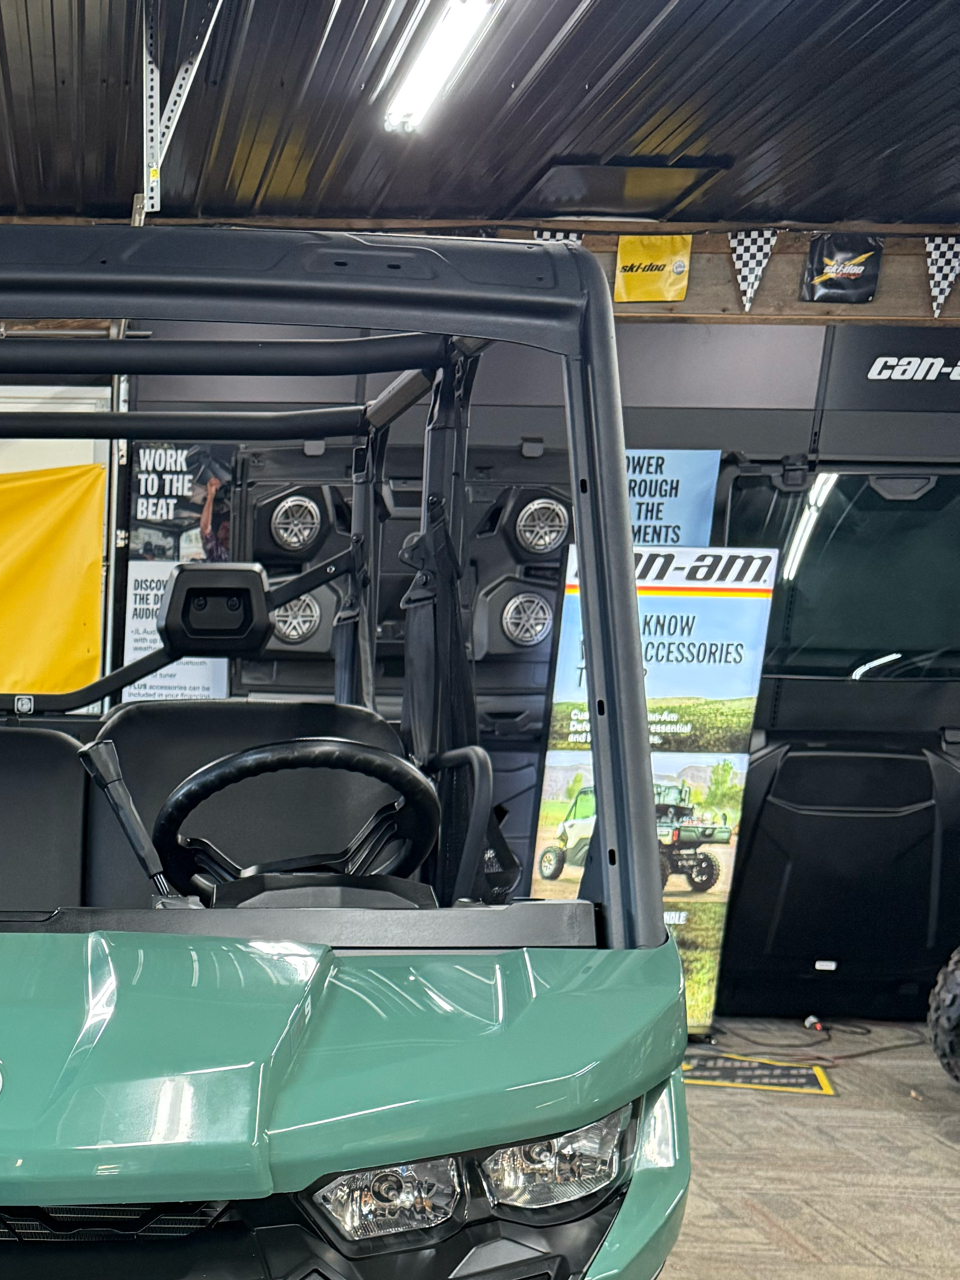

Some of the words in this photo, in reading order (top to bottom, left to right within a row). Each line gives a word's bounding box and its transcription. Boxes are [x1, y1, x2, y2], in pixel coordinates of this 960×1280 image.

[620, 263, 666, 272] ski-doo
[139, 449, 188, 472] WORK
[138, 474, 159, 495] TO
[162, 474, 193, 496] THE
[137, 498, 177, 520] BEAT
[636, 502, 664, 520] THE
[133, 594, 150, 605] THE
[642, 614, 695, 636] KNOW
[644, 641, 744, 664] CCESSORIES
